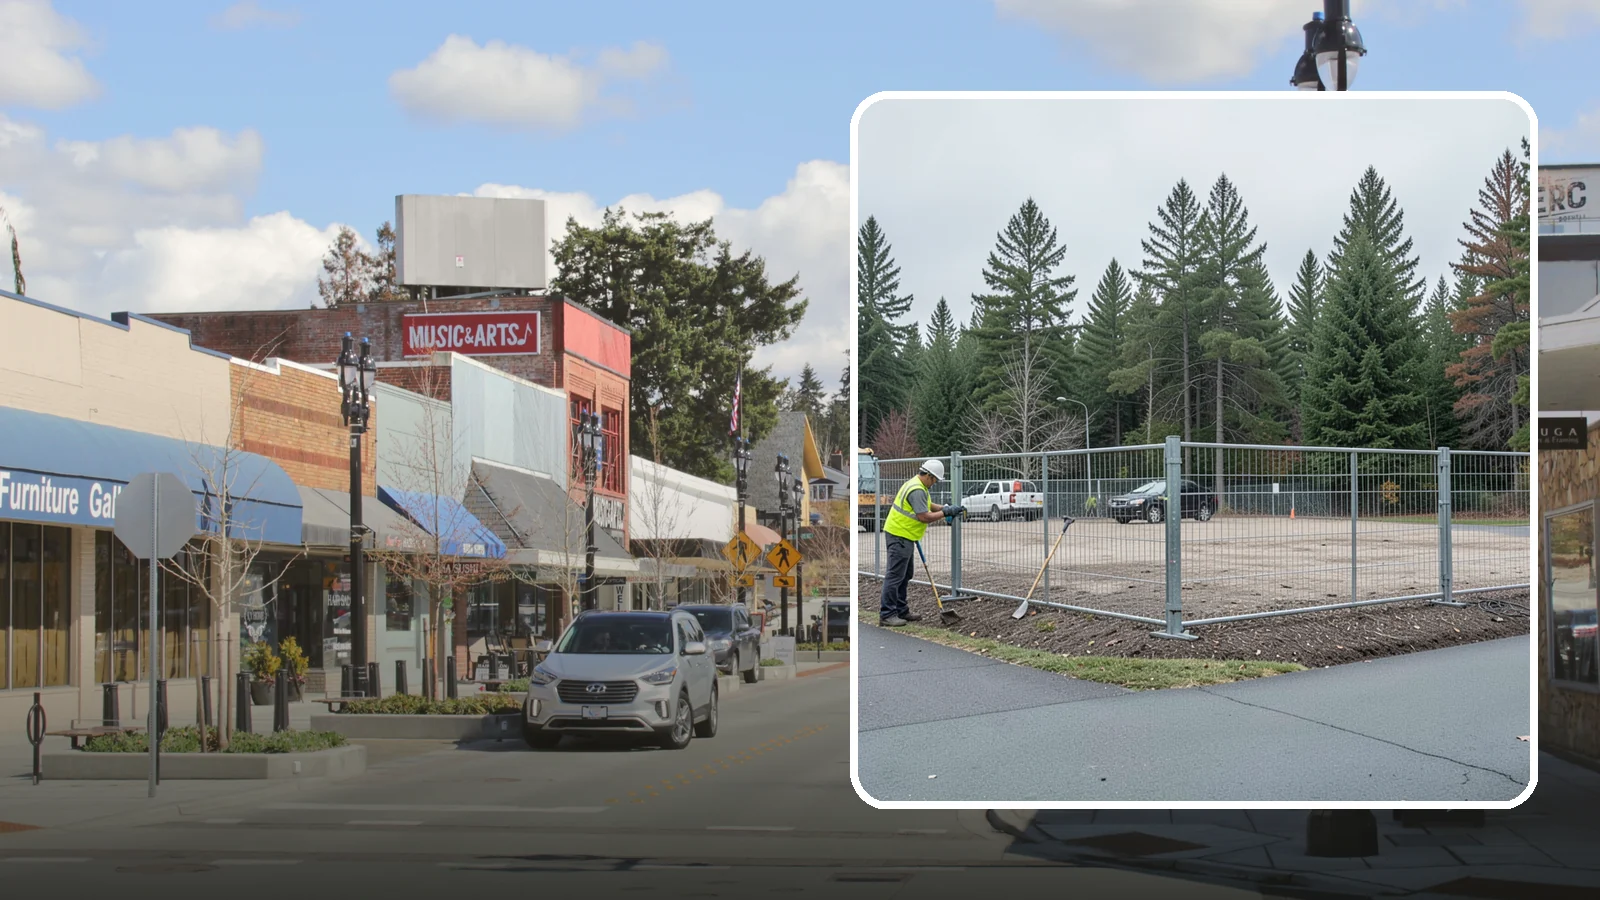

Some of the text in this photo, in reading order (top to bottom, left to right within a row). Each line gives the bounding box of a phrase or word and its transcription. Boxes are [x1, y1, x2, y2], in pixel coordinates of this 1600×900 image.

[0, 471, 122, 519] Furniture Gal
[454, 563, 479, 574] SUSHI
